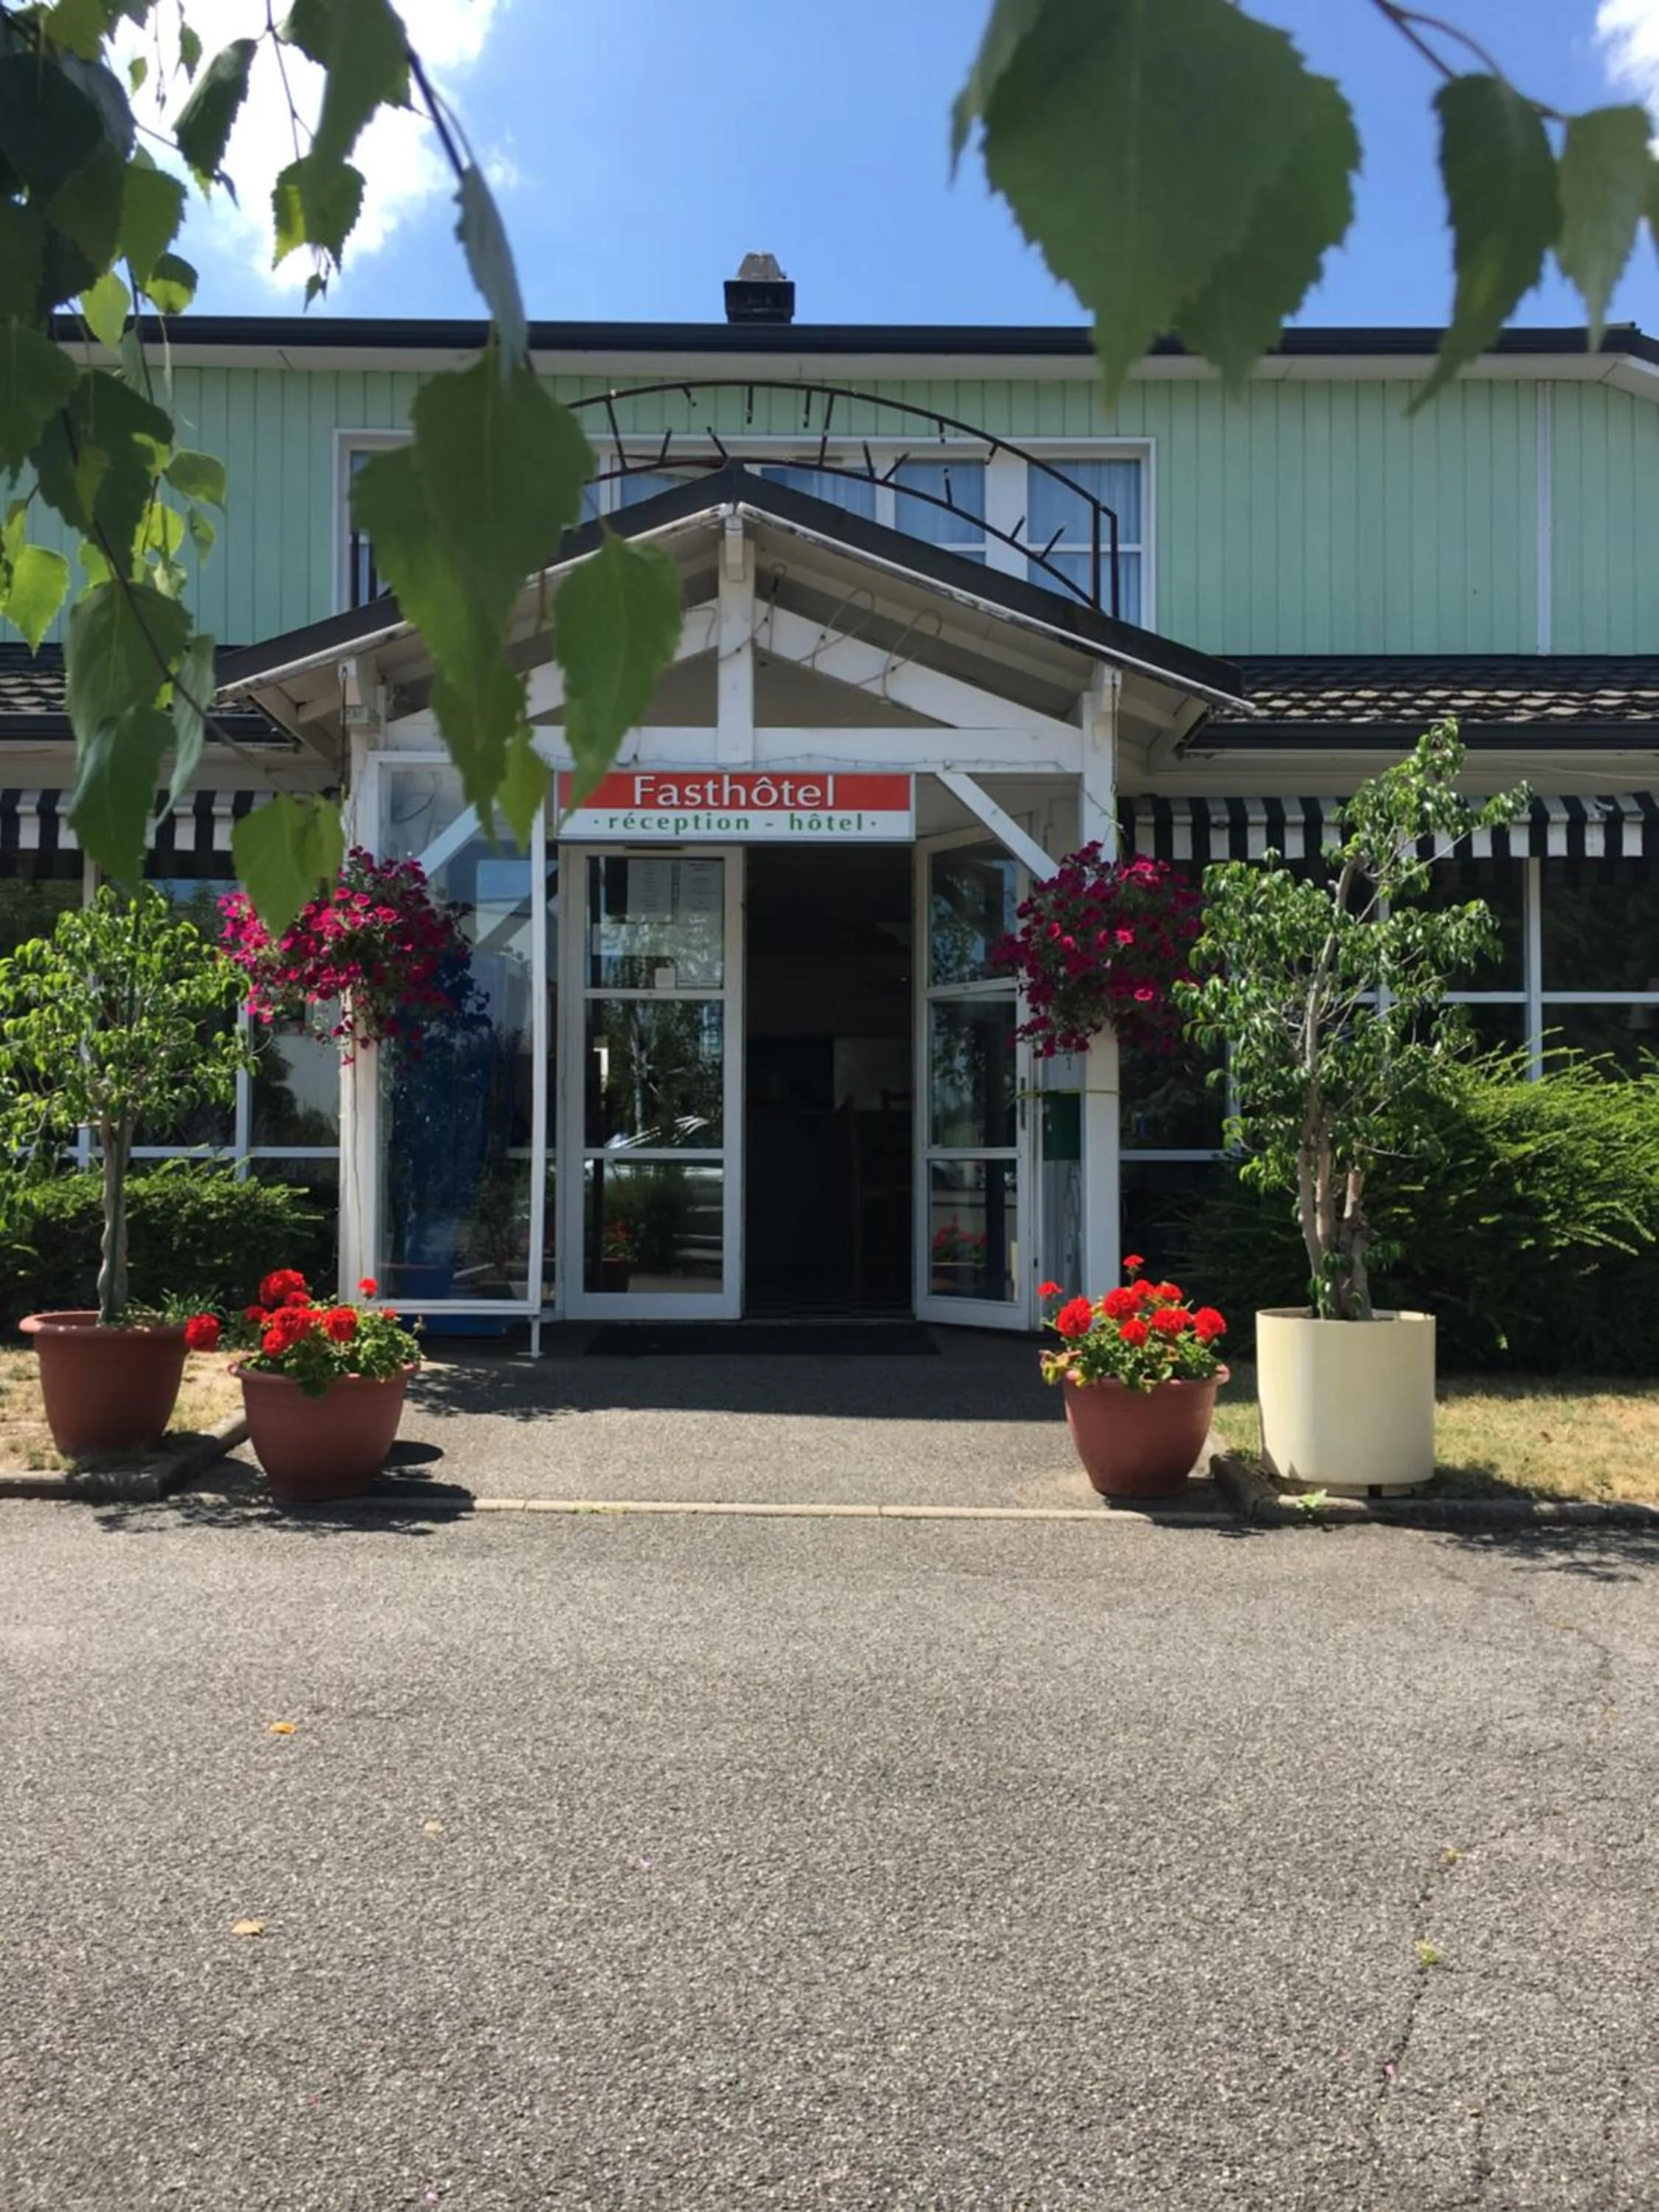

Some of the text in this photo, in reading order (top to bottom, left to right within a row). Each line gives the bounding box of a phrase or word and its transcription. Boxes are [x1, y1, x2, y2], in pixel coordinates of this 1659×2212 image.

[633, 774, 835, 807] Fasthôtel
[608, 812, 750, 835] réception
[789, 812, 863, 832] hôtel
